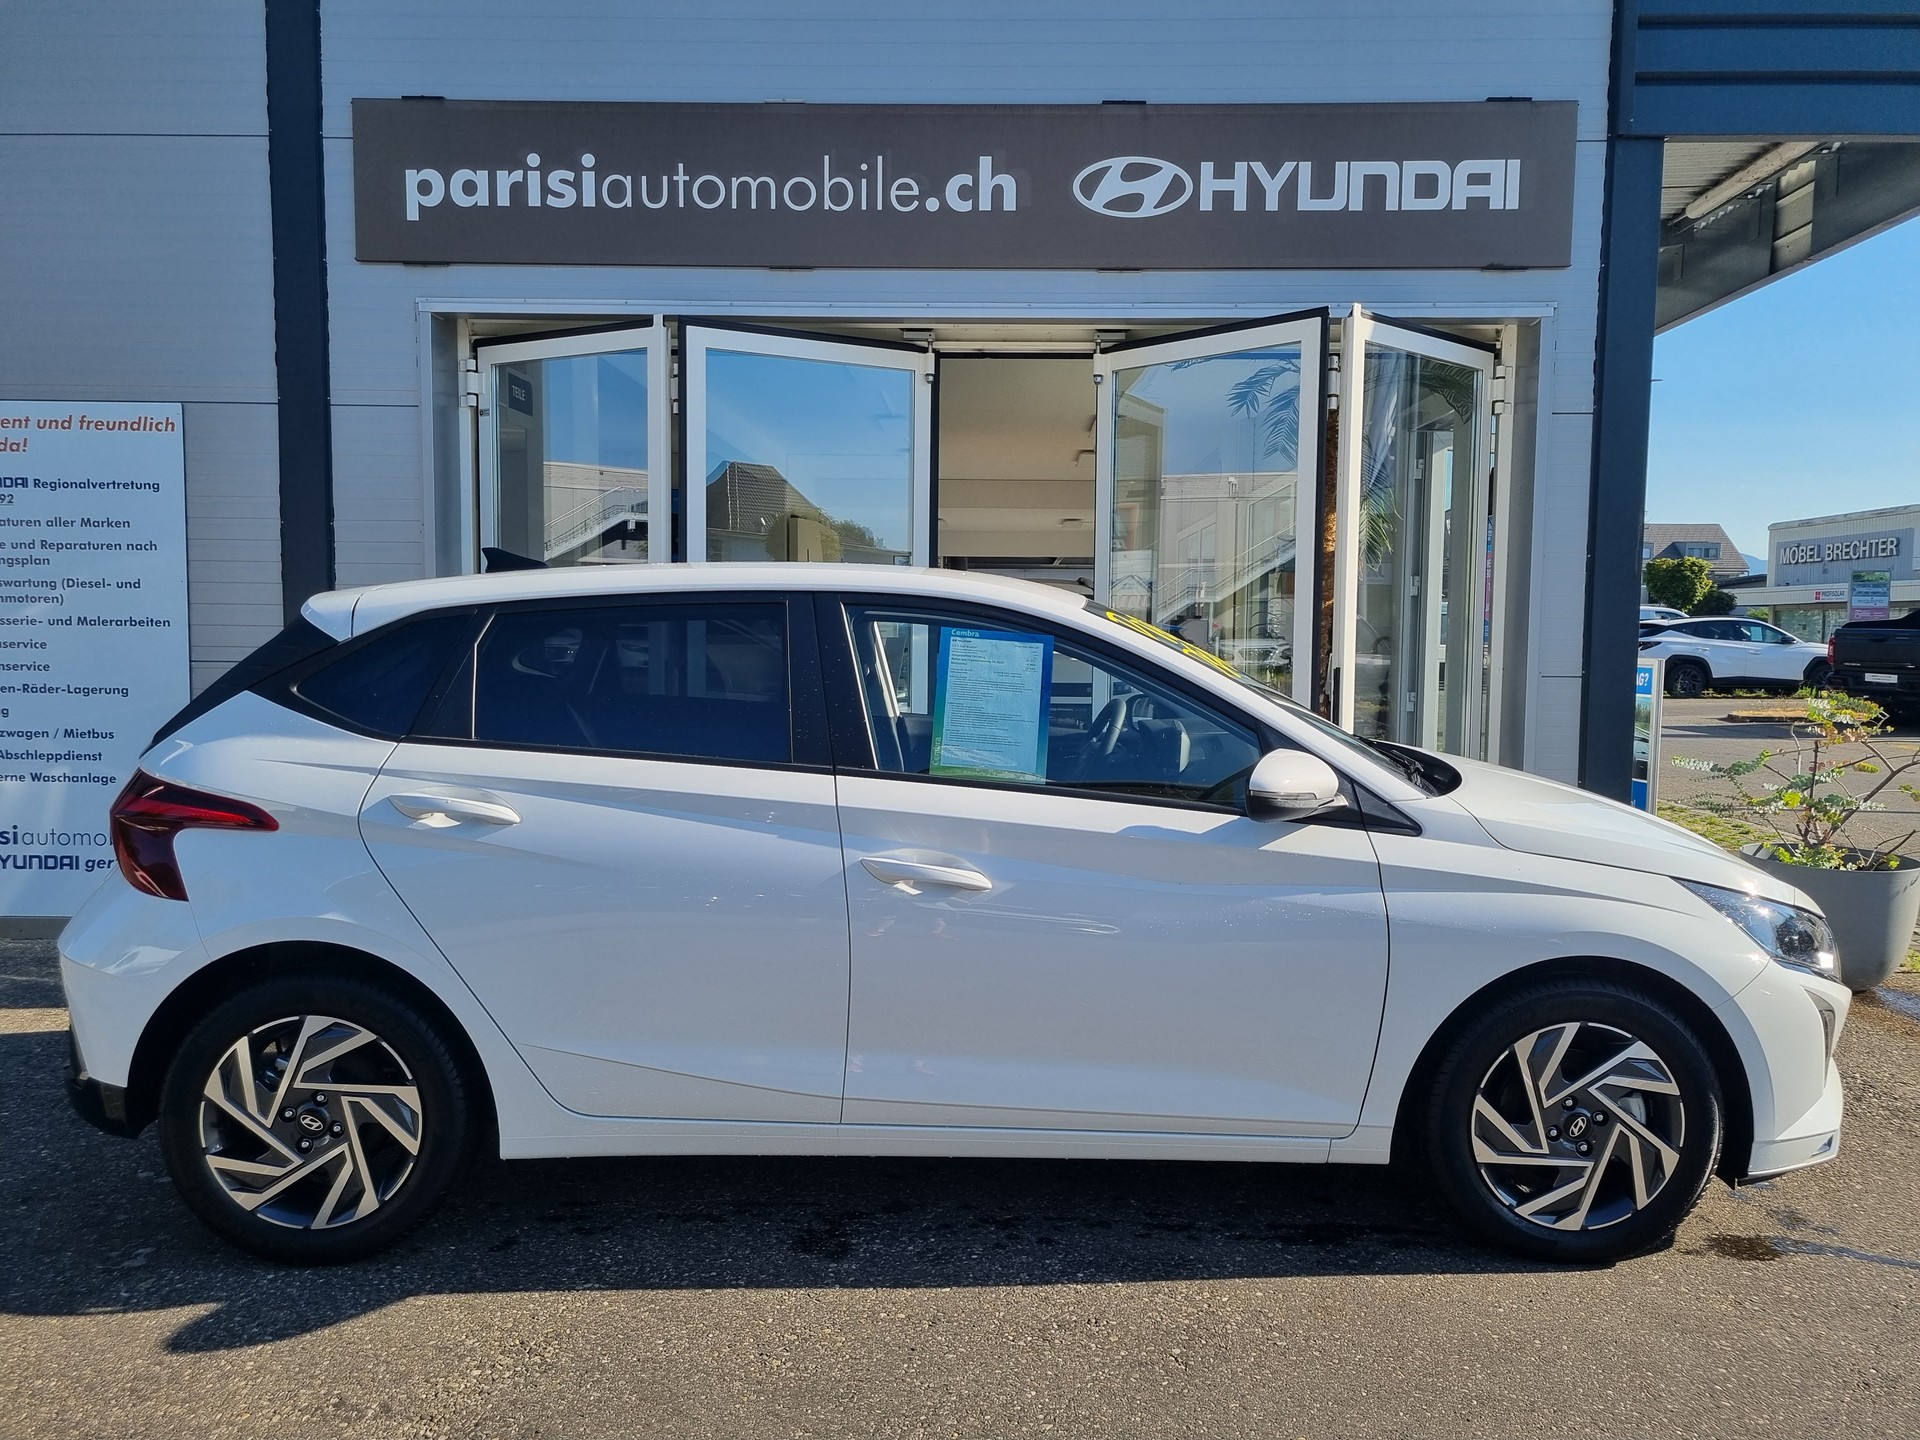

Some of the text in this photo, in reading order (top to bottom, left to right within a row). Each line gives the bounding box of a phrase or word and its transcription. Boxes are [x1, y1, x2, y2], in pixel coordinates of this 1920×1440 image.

[404, 152, 1018, 221] parisiautomobile.ch
[1199, 158, 1521, 212] HYUNDAI
[512, 385, 526, 401] TEILE
[36, 416, 73, 430] und
[79, 415, 176, 432] freundlich
[0, 476, 160, 493] DAI Regionalvertretung
[46, 516, 76, 528] aller
[80, 517, 131, 529] Marken
[11, 539, 36, 550] und
[40, 540, 122, 553] Reparaturen
[126, 540, 158, 551] nach
[1780, 537, 1900, 565] MÖBEL BRECHTER
[61, 577, 112, 591] (Diesel-
[116, 578, 141, 589] und
[47, 615, 73, 627] und
[76, 615, 171, 628] Malerarbeiten
[951, 629, 980, 638] Cembra
[0, 639, 47, 650] service
[0, 683, 129, 698] en-Räder-Lagerung
[63, 728, 115, 739] Mietbus
[30, 772, 117, 786] Waschanlage
[0, 824, 113, 847] siautomo
[84, 859, 118, 873] ger
